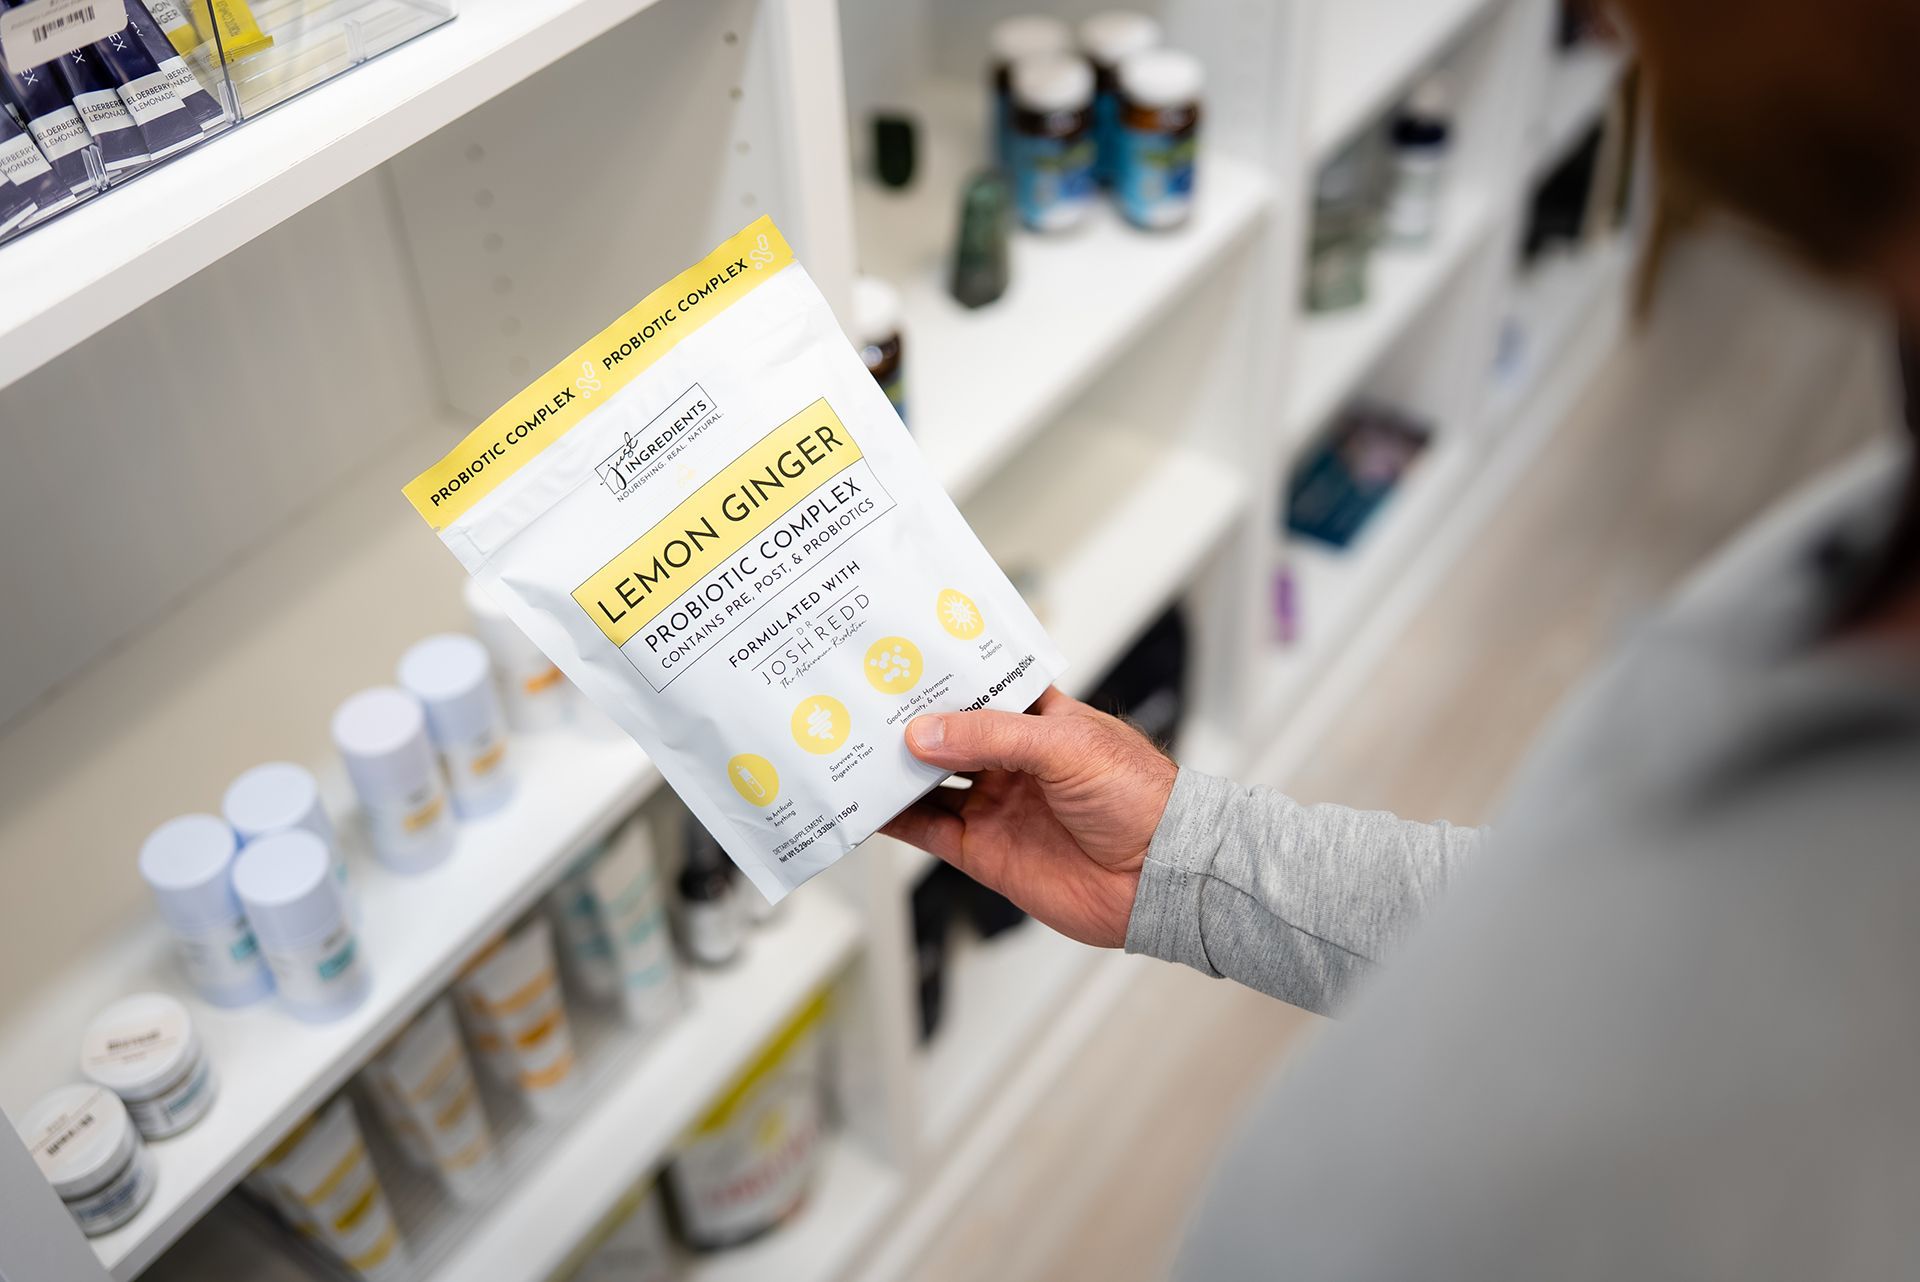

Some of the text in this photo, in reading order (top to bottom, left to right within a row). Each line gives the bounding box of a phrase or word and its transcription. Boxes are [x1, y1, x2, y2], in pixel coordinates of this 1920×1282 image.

[82, 99, 123, 115] ELDERBERR
[126, 82, 172, 106] ELDERBERRY
[133, 91, 176, 113] LEMONADE
[37, 116, 82, 141] ELDERBERR
[602, 258, 748, 370] PROBIOTIC COMPLEX
[430, 387, 576, 507] PROBIOTIC COMPLEX
[617, 412, 725, 502] NOURISHING. REAL. NATURAL.
[625, 400, 707, 473] INGREDIENTS
[600, 431, 639, 491] just
[597, 425, 844, 624] LEMON GINGER
[645, 477, 861, 653] PROBIOTIC COMPLEX
[661, 498, 874, 669] CONTAINS PRE, POST, & PROBIOTICS
[728, 560, 860, 668] FORMULATED WITH
[796, 620, 813, 636] DR
[762, 594, 870, 685] JOSH REDD
[932, 686, 949, 700] More
[989, 671, 1023, 697] Serving
[1018, 654, 1036, 671] Sticks
[886, 710, 902, 725] Good
[900, 704, 910, 712] for
[922, 673, 955, 696] Hormones,
[829, 742, 865, 772] Survives The
[831, 746, 874, 782] Digestive Tract
[772, 798, 794, 819] Artificial
[789, 814, 826, 845] SUPPLEMENT
[835, 800, 859, 823] (150g)
